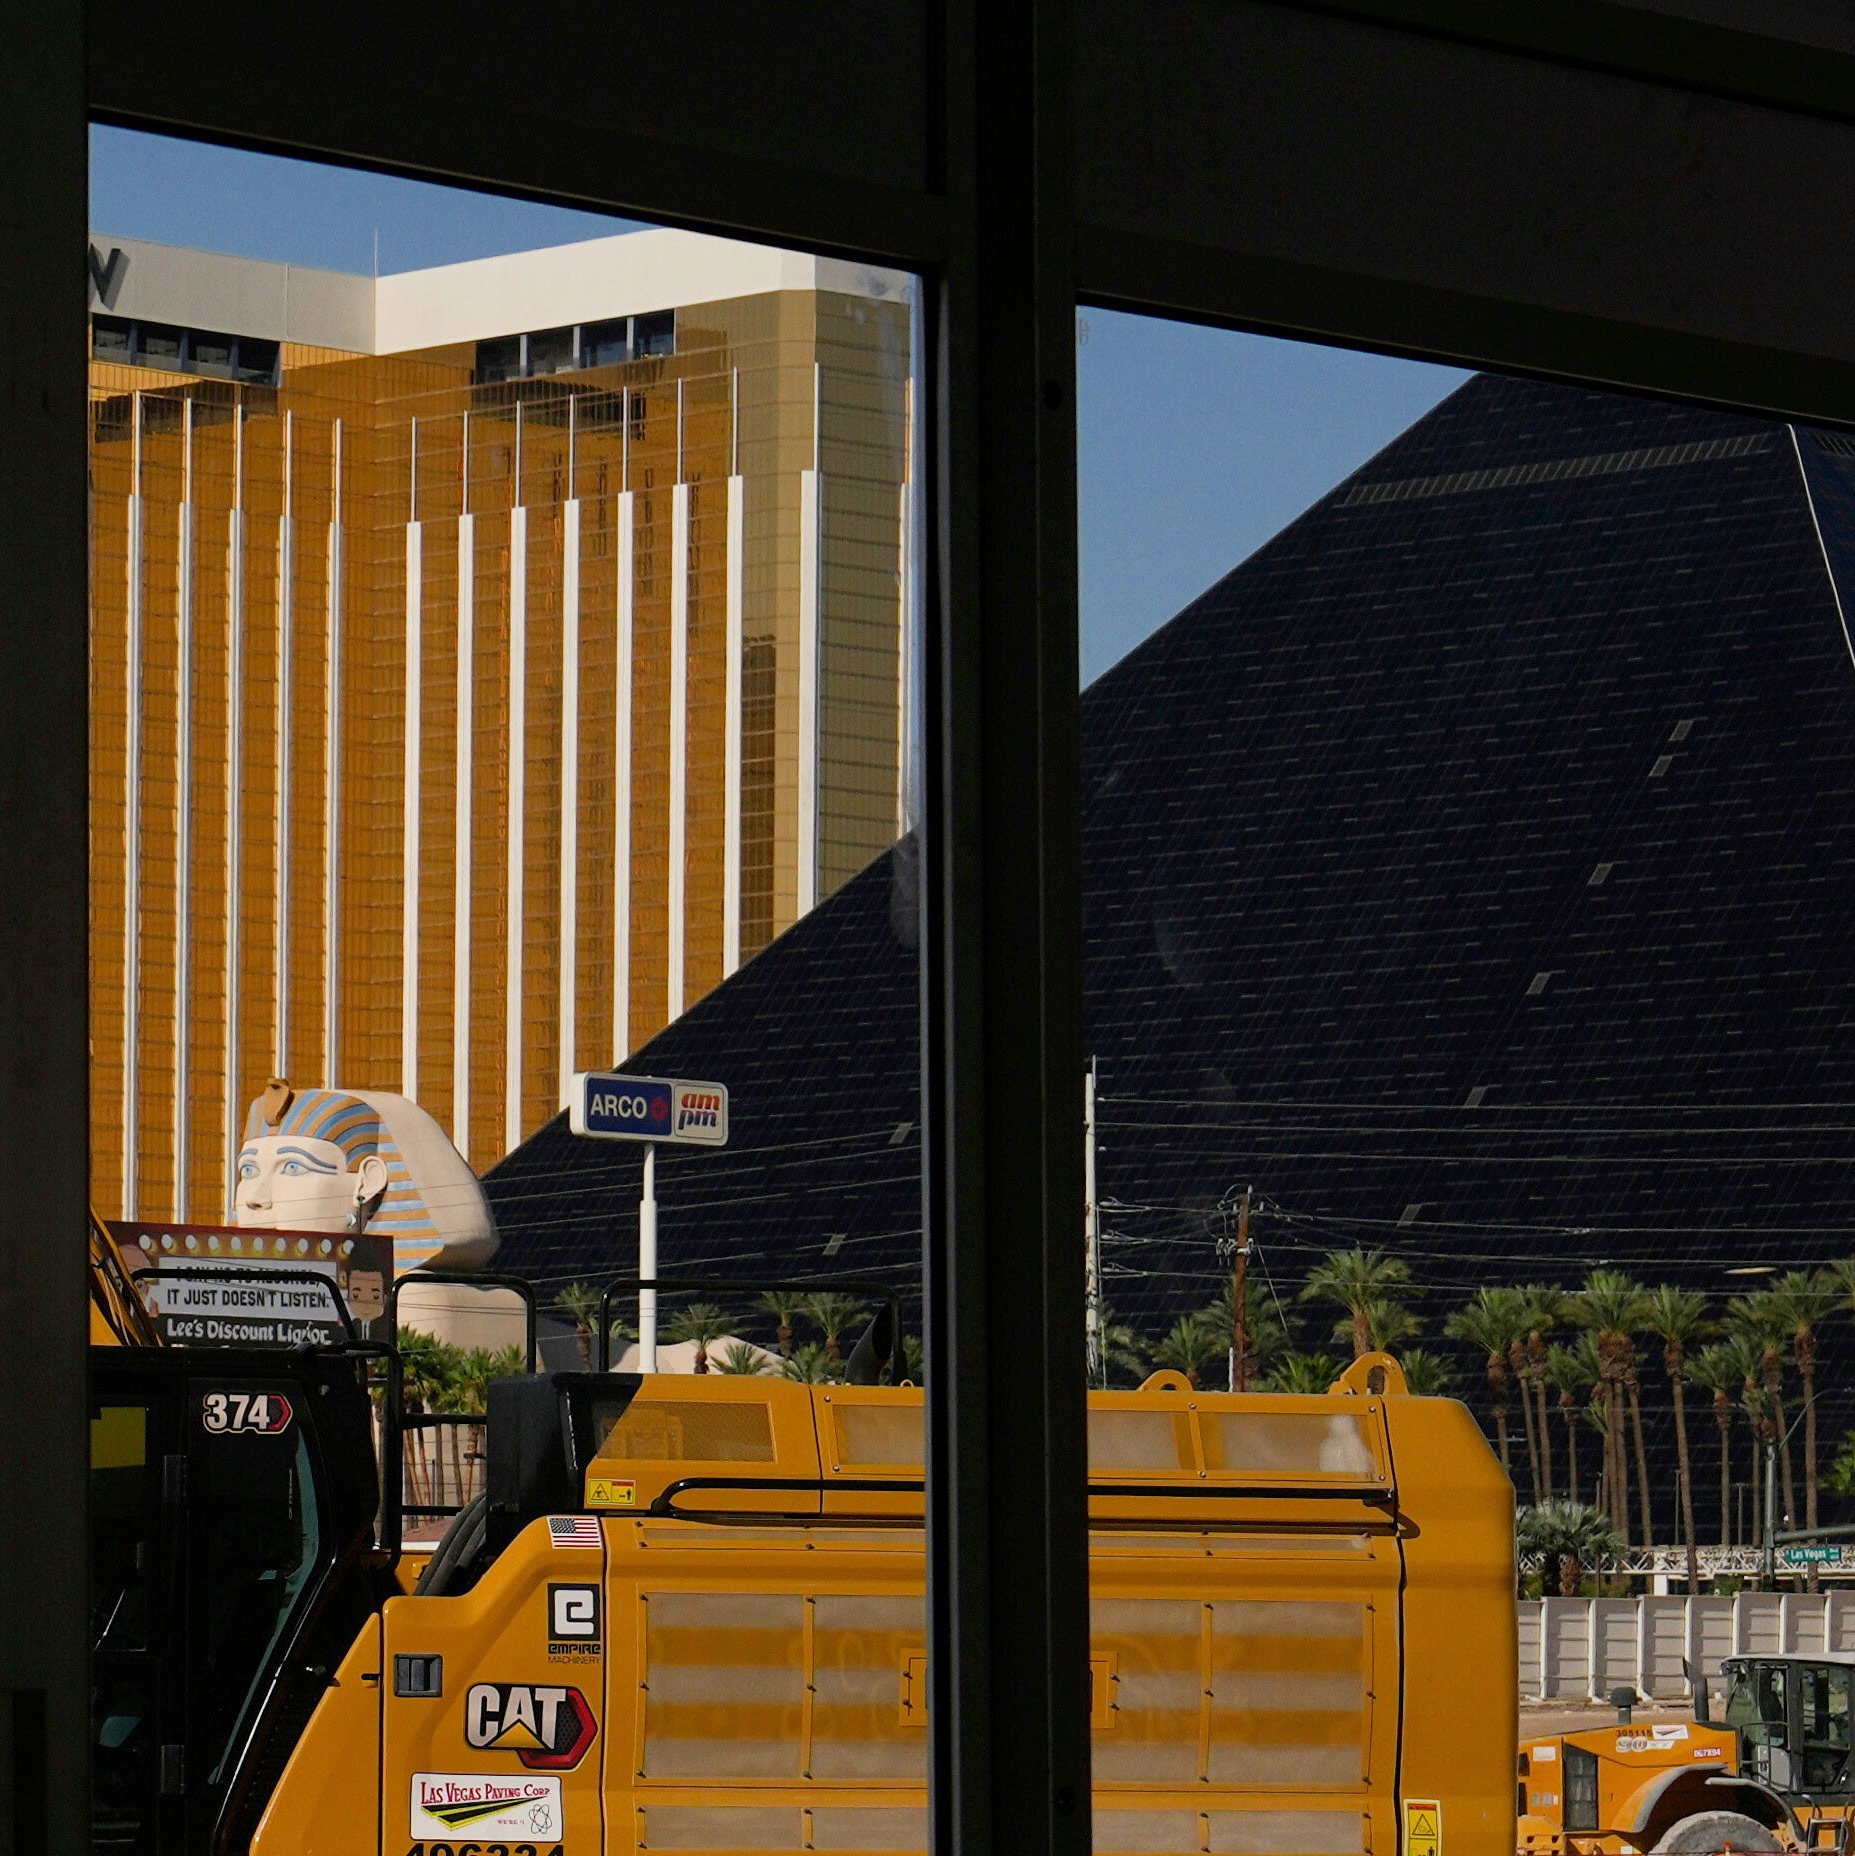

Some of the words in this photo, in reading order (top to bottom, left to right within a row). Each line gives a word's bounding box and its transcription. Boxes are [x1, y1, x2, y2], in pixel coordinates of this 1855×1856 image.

[590, 1094, 647, 1119] ARCO
[681, 1093, 720, 1110] am
[678, 1109, 717, 1130] pm
[167, 1289, 180, 1305] IT
[184, 1289, 217, 1306] JUST
[222, 1290, 277, 1307] DOESN'T
[280, 1293, 330, 1309] LISTEN.
[167, 1318, 204, 1338] Lee's
[207, 1320, 274, 1341] Discount
[206, 1394, 270, 1429] 374
[1790, 1549, 1803, 1560] Las
[1803, 1548, 1826, 1561] Vegas
[468, 1685, 566, 1750] CAT
